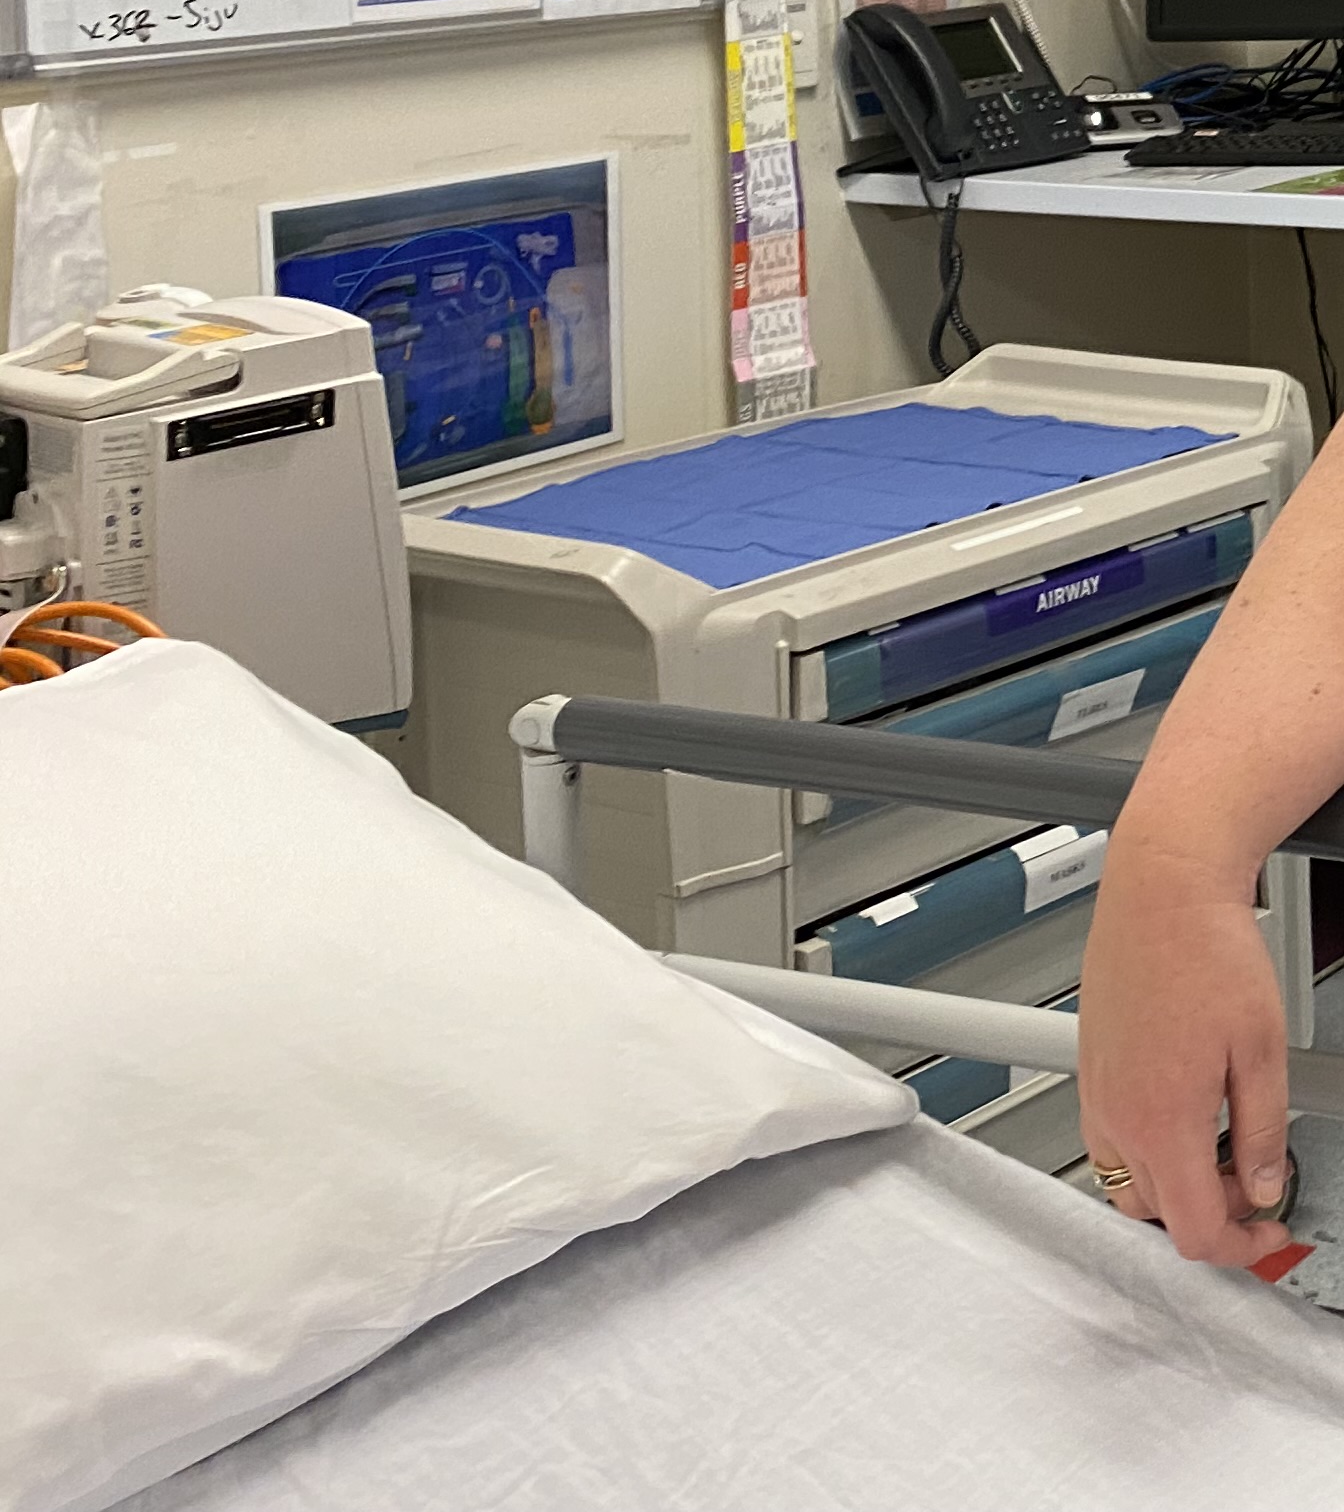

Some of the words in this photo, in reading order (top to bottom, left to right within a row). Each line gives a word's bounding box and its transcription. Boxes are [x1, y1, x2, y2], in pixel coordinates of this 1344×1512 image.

[734, 173, 746, 224] PURPLE
[734, 262, 746, 289] RED
[1036, 575, 1100, 612] AIRWAY
